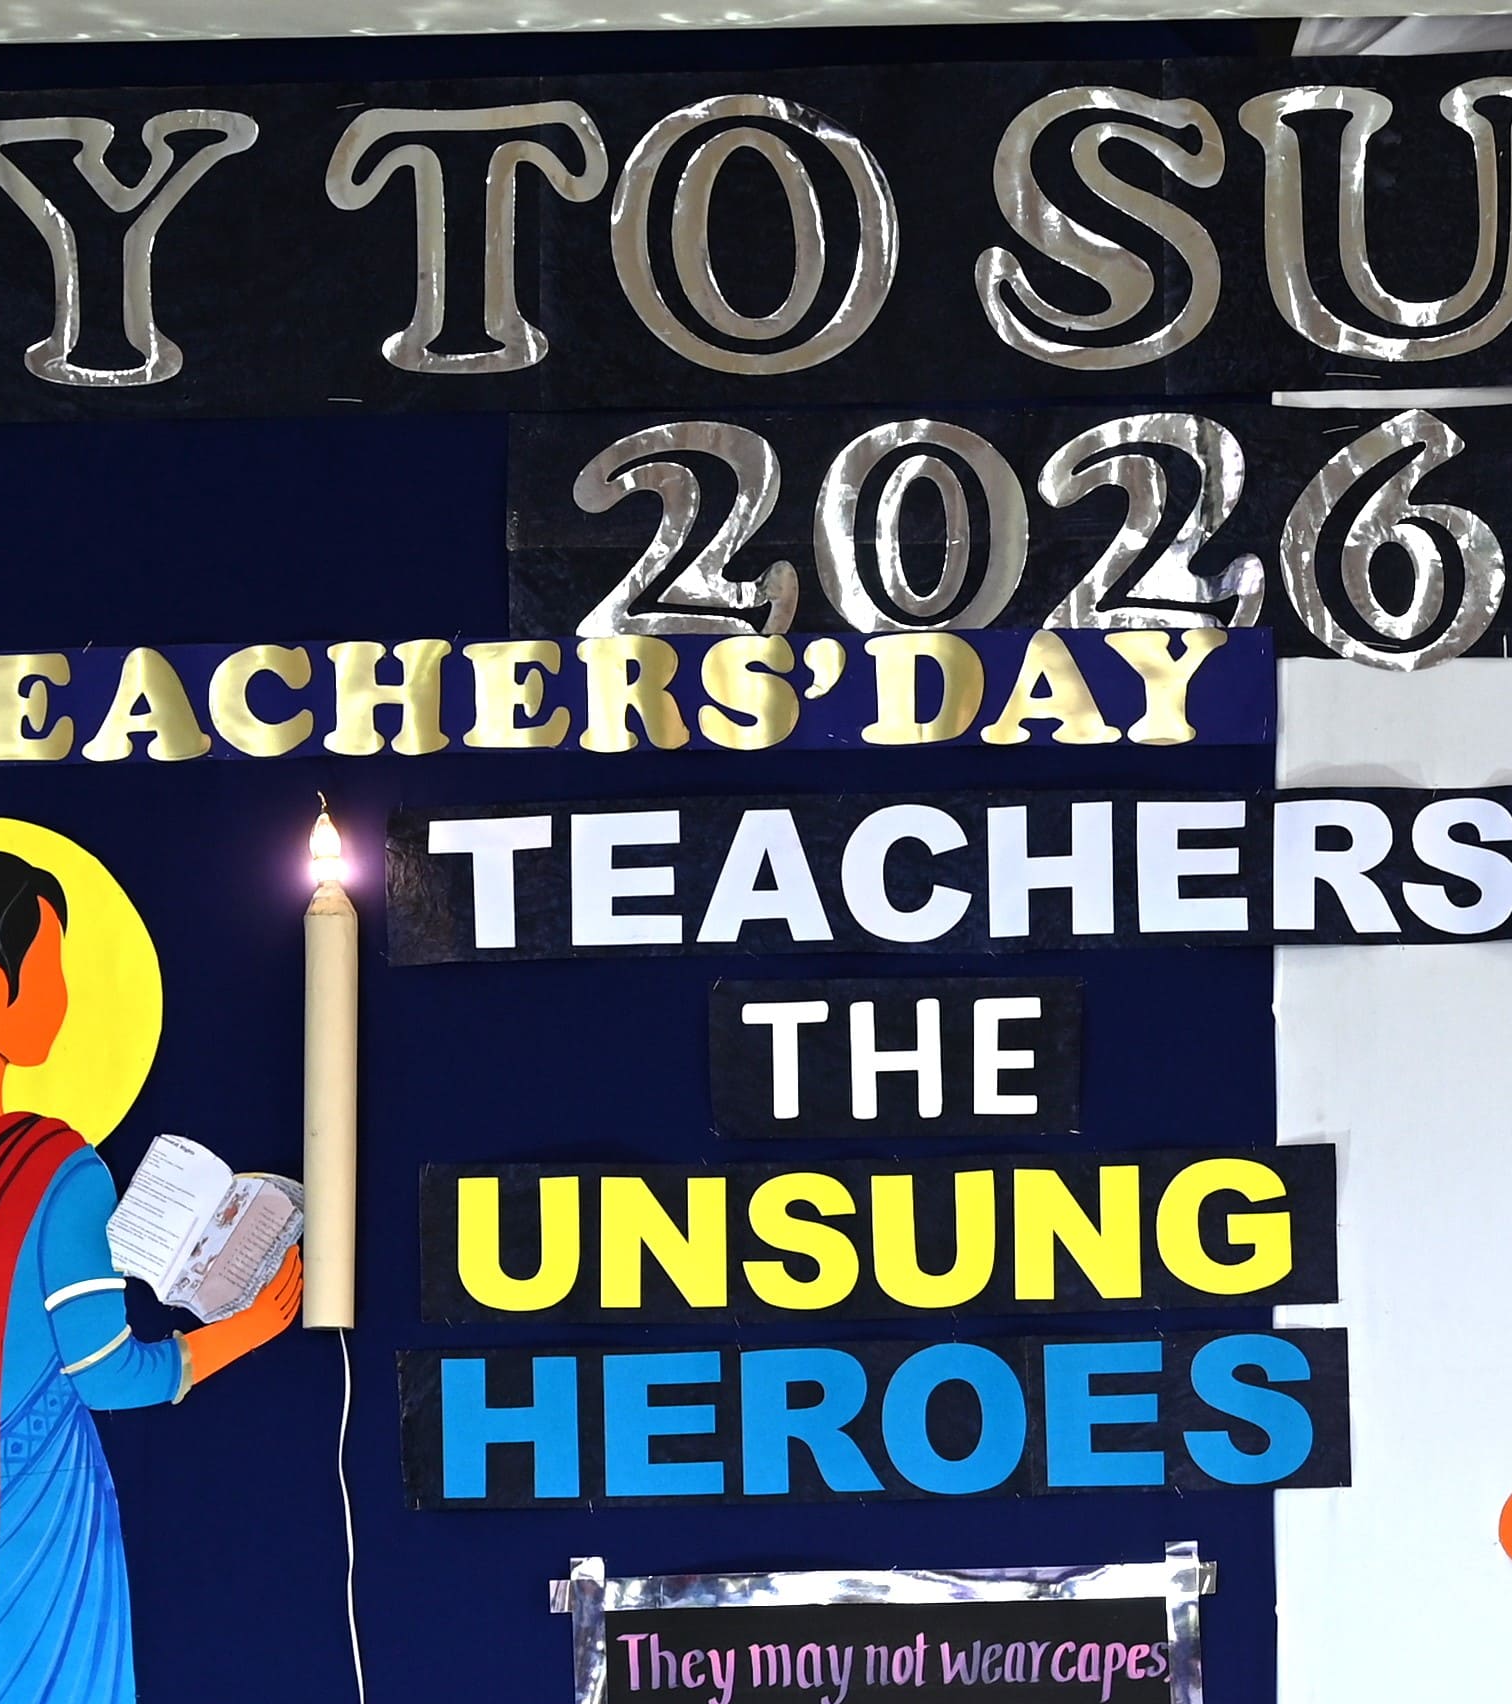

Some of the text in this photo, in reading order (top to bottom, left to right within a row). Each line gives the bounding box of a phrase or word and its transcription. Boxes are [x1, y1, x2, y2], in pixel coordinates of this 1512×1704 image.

[325, 94, 900, 377] TO
[740, 996, 1043, 1121] THE
[455, 1157, 1294, 1313] UNSUNG
[439, 1334, 1316, 1500] HEROES
[865, 1632, 930, 1689] not
[940, 1640, 1051, 1686] wear
